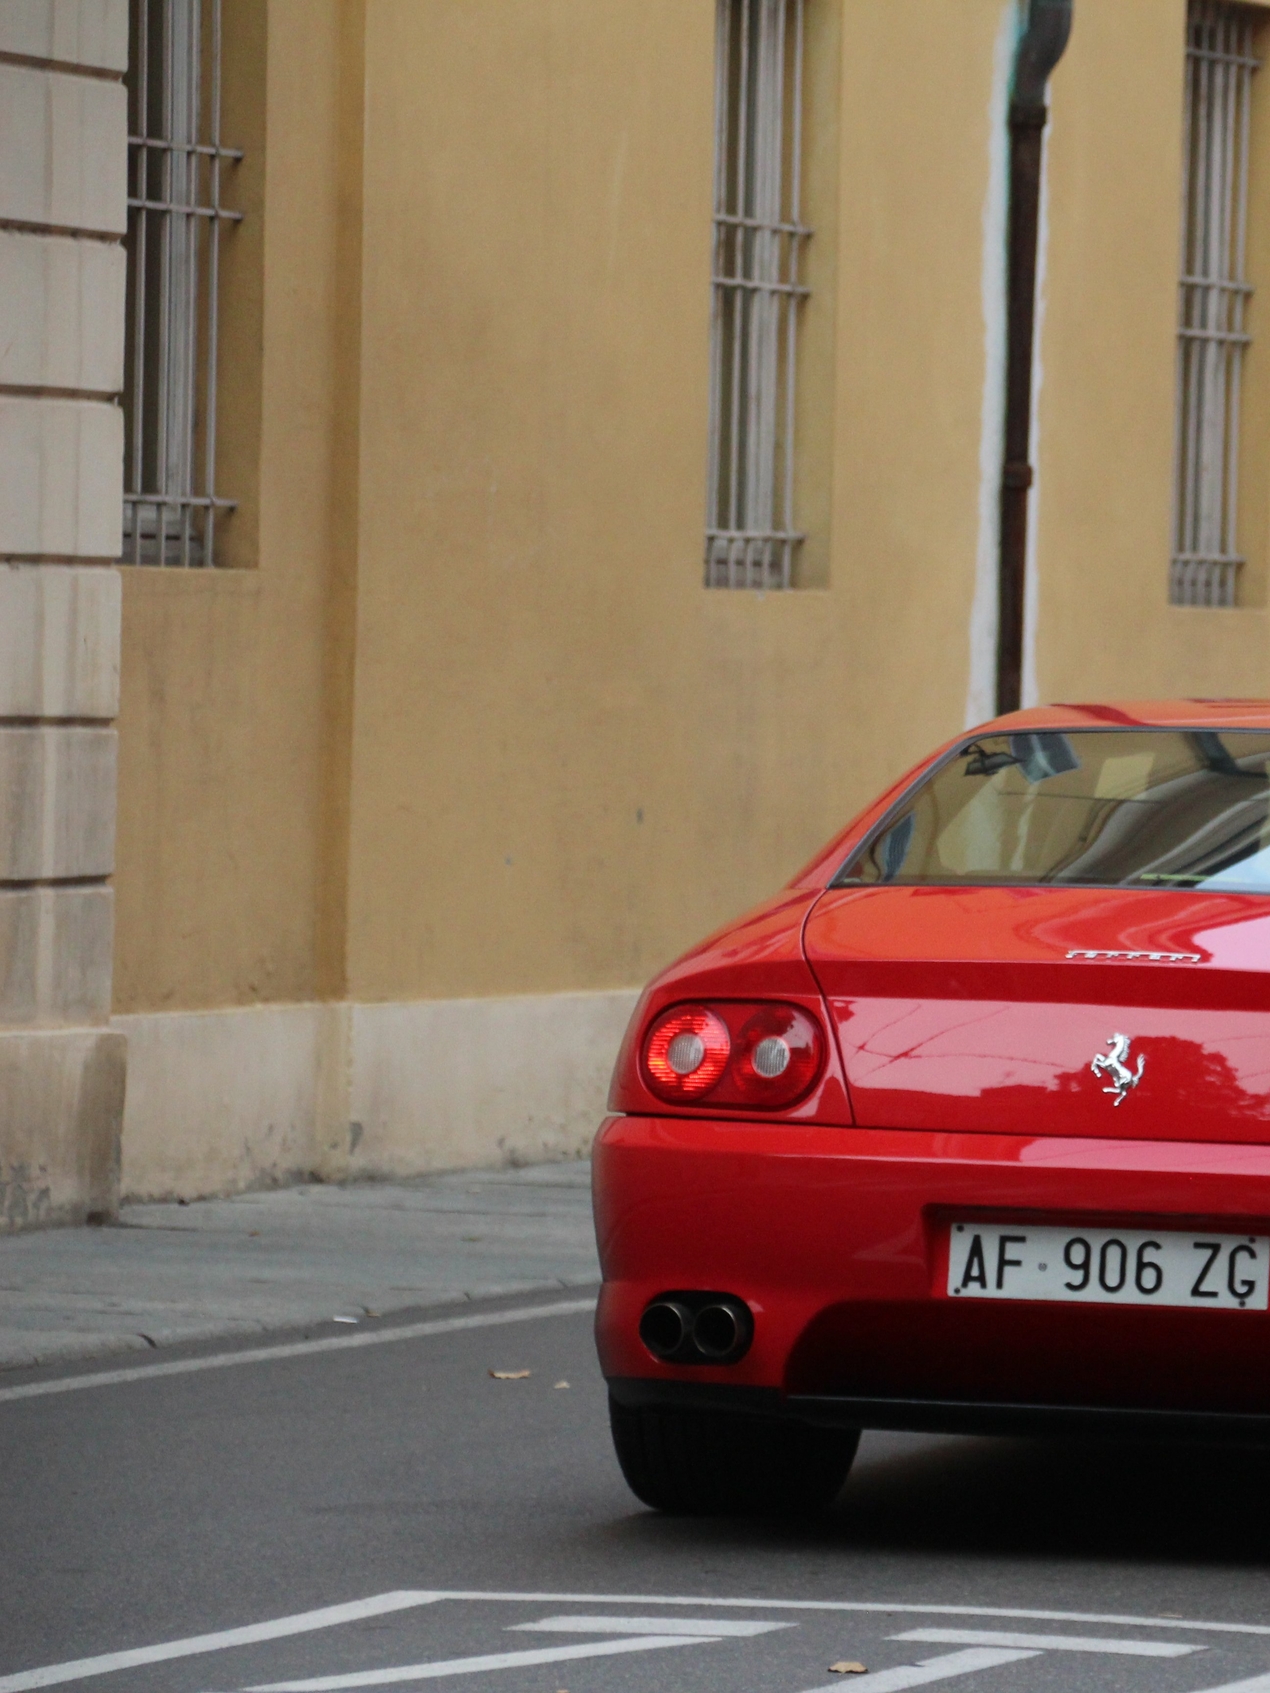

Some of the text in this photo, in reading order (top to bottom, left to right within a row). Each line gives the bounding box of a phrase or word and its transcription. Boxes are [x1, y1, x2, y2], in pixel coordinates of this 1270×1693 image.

[961, 1233, 1257, 1300] AF 906 ZG
